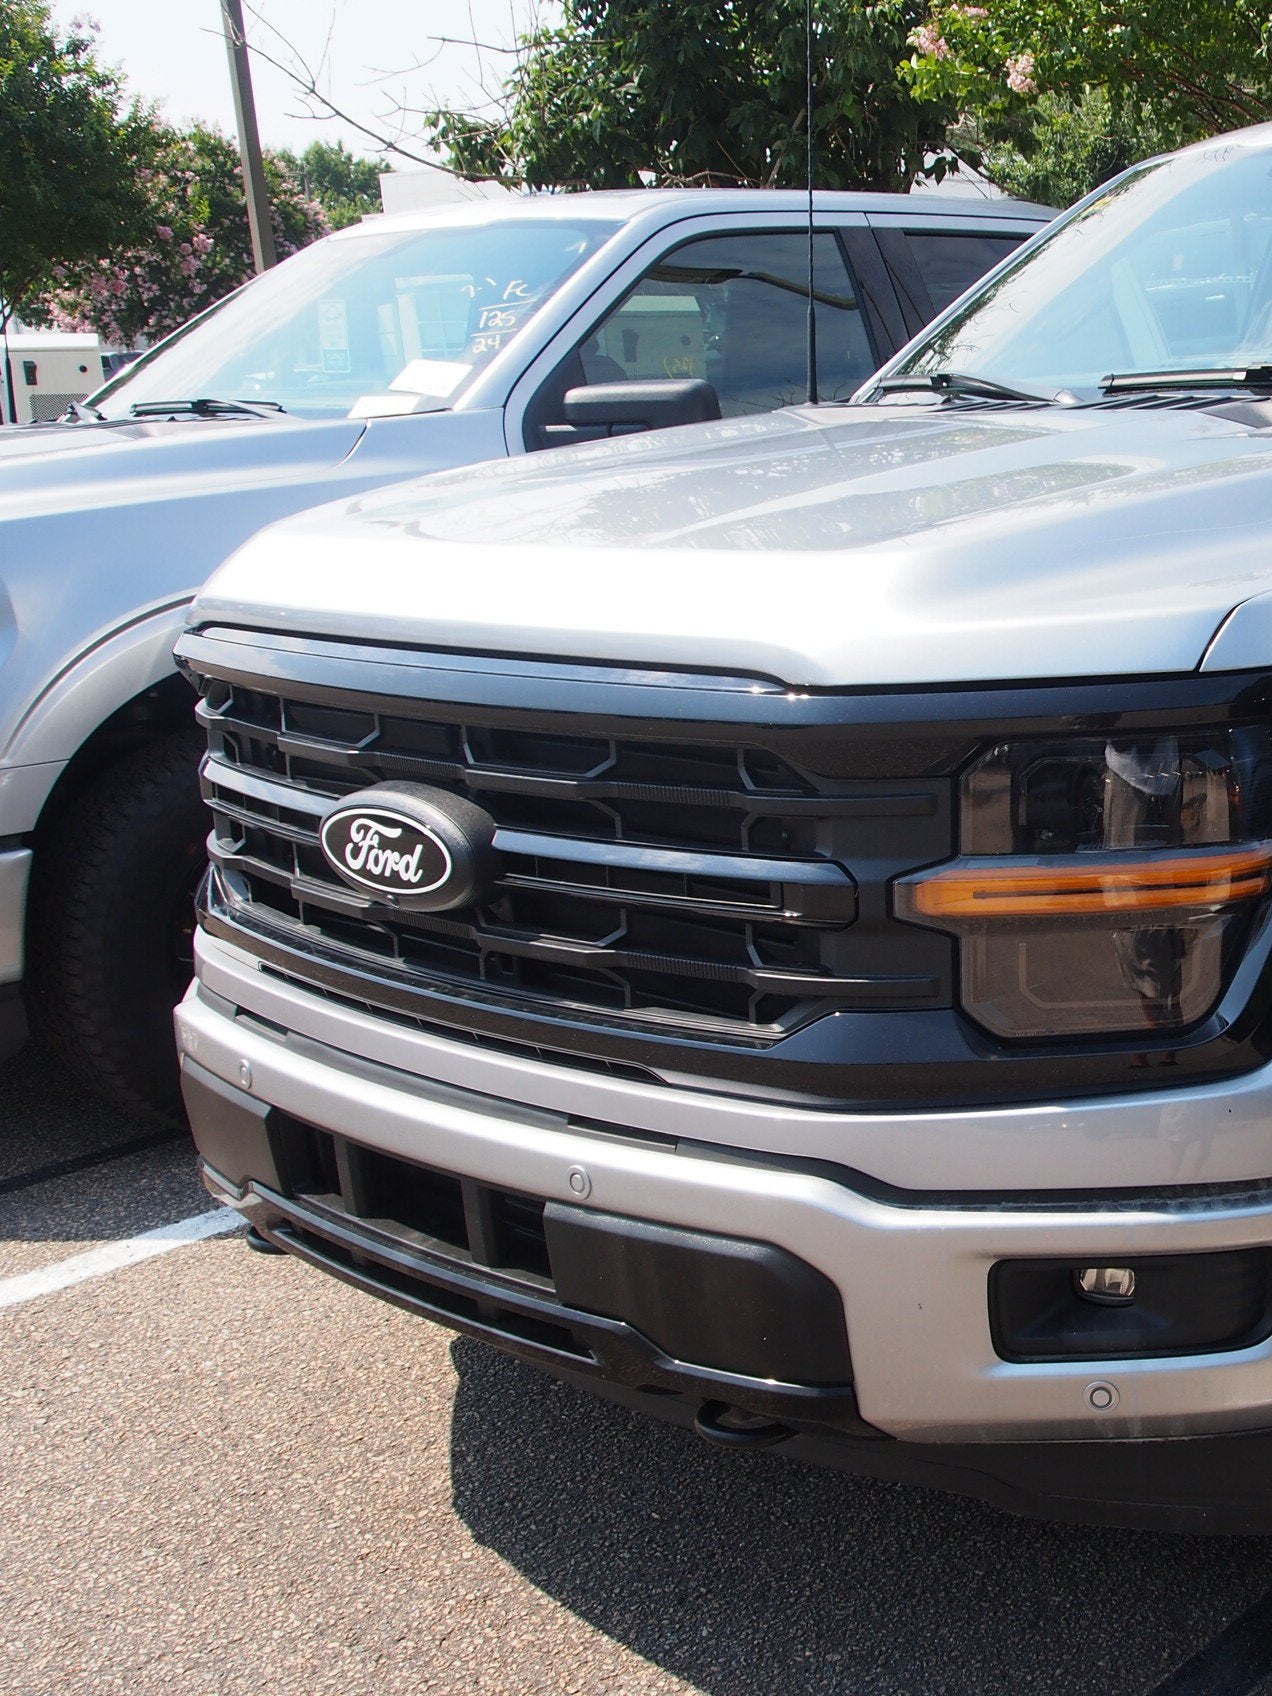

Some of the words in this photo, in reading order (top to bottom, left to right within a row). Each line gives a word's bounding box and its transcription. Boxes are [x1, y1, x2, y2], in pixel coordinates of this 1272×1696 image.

[479, 310, 517, 329] 125
[472, 334, 500, 354] 24
[345, 818, 423, 883] Ford
